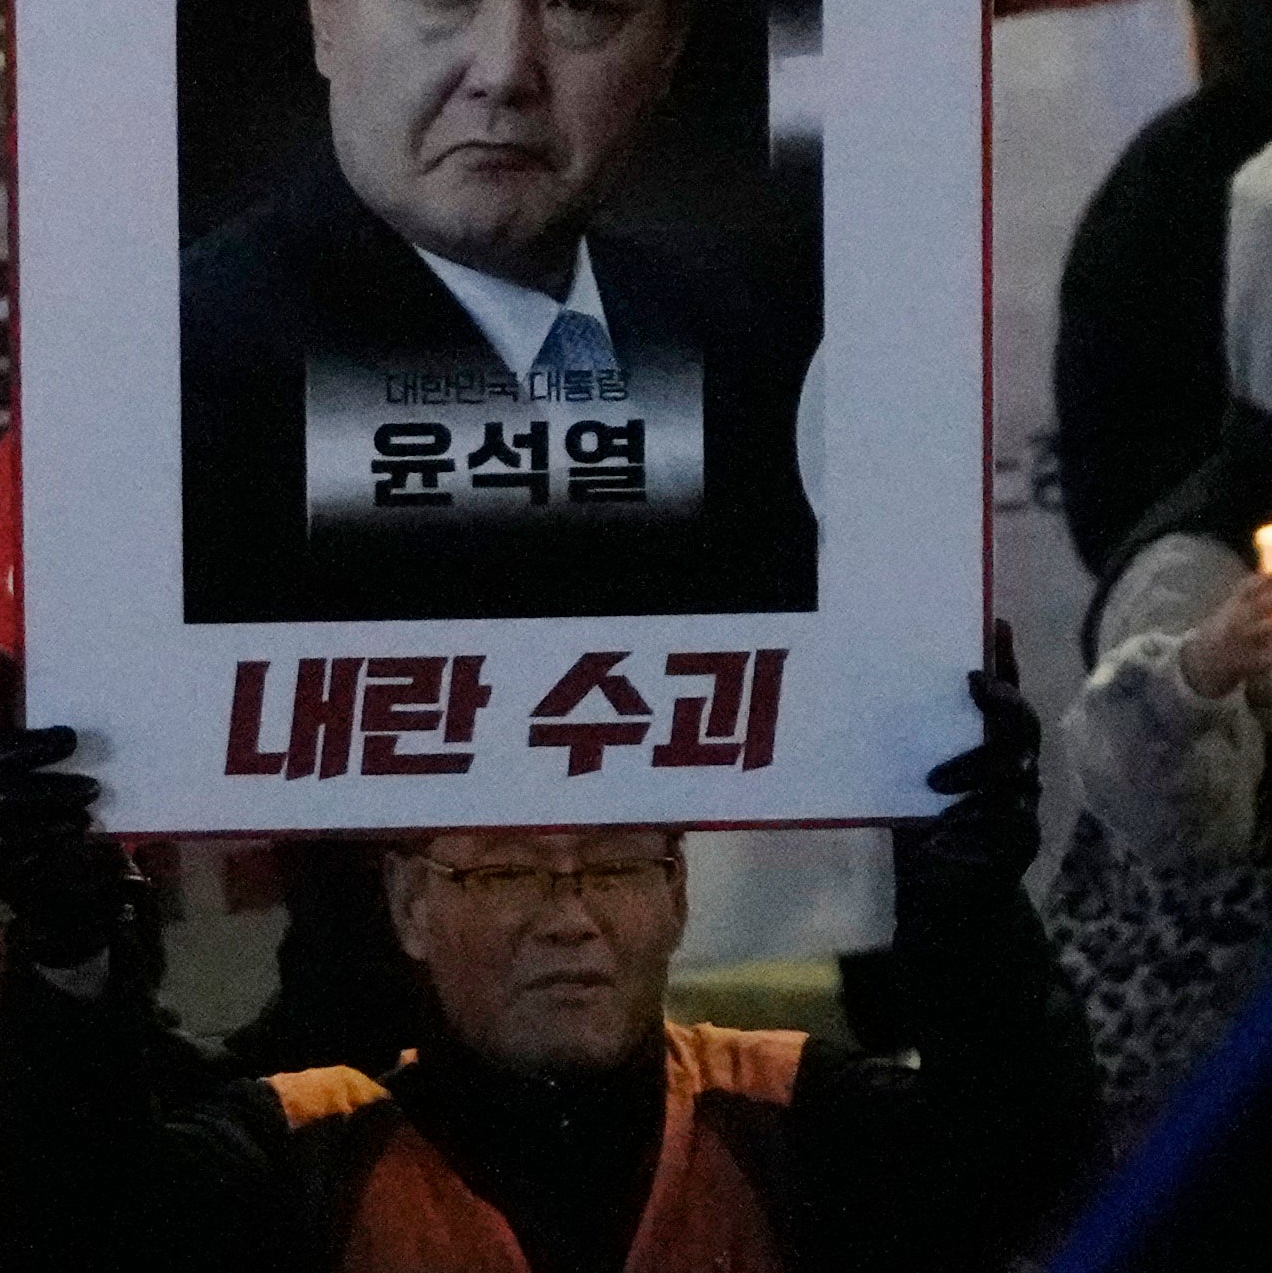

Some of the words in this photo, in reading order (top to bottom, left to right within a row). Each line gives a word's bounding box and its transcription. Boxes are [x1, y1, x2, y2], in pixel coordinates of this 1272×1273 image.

[385, 370, 520, 406] 대한민국
[528, 368, 629, 403] 대통령
[371, 418, 646, 507] 윤석열
[224, 654, 493, 781] 내란
[529, 648, 790, 777] 수괴
